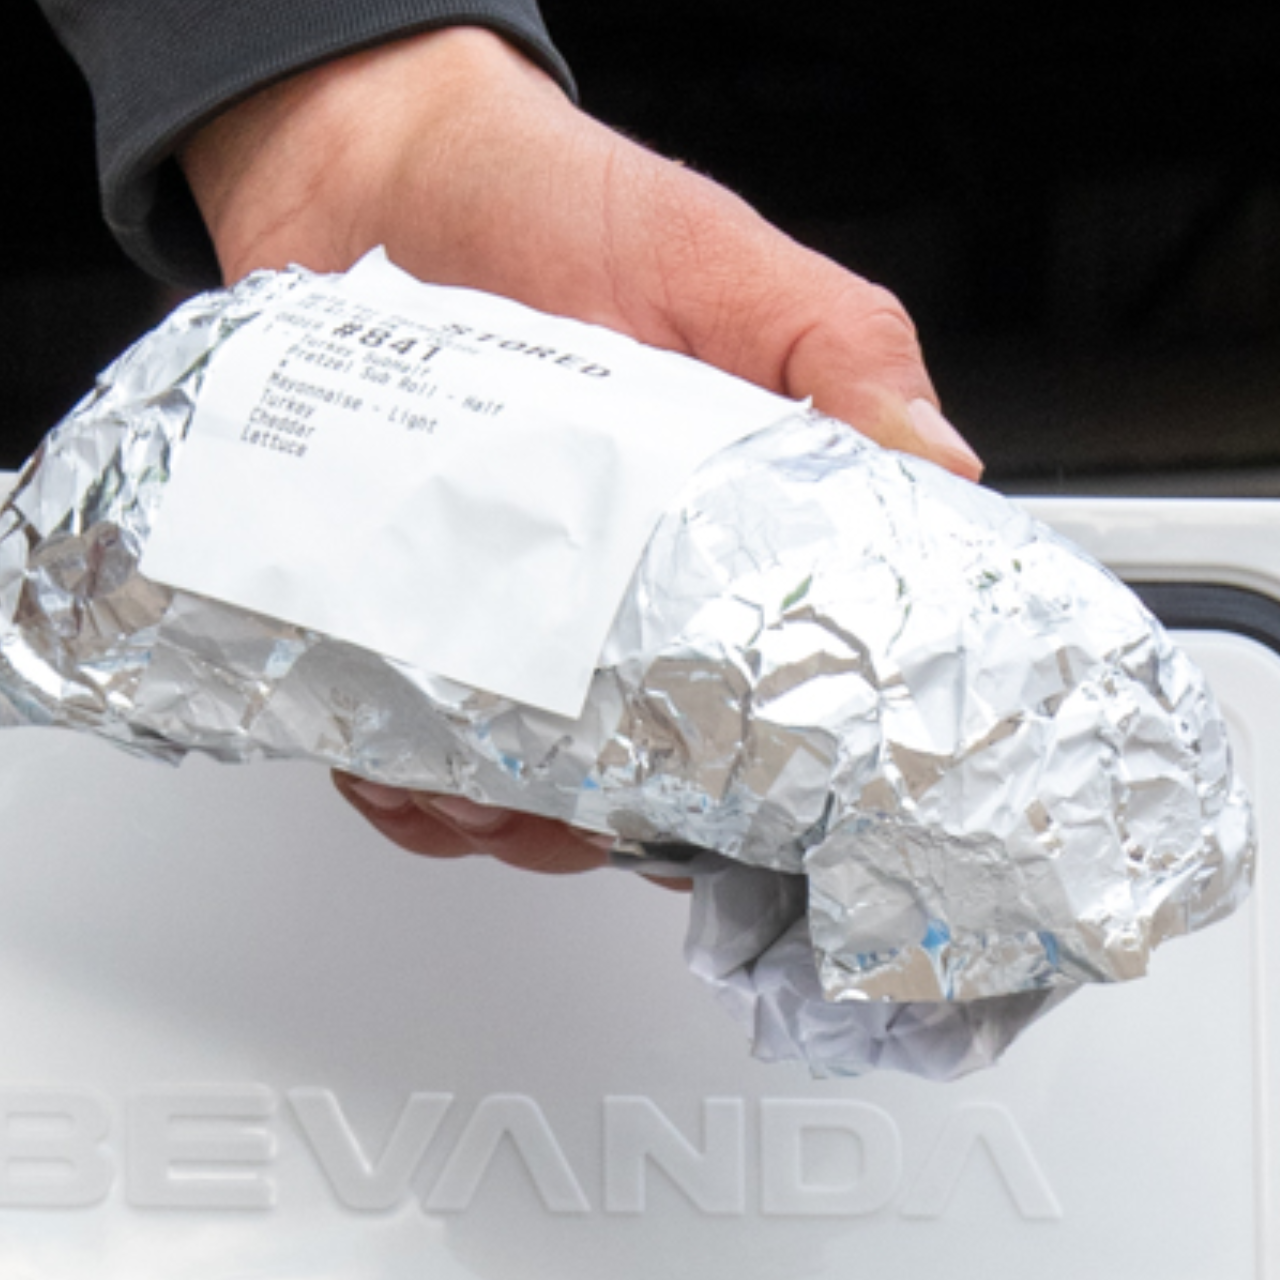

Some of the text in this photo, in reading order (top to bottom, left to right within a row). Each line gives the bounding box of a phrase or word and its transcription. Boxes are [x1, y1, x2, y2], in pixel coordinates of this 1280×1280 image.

[332, 321, 442, 362] #841
[441, 322, 612, 378] STORED
[259, 387, 317, 420] Turkey
[266, 370, 364, 412] Mayonnaise
[239, 423, 309, 458] Lettuce
[249, 406, 316, 438] Cheddar
